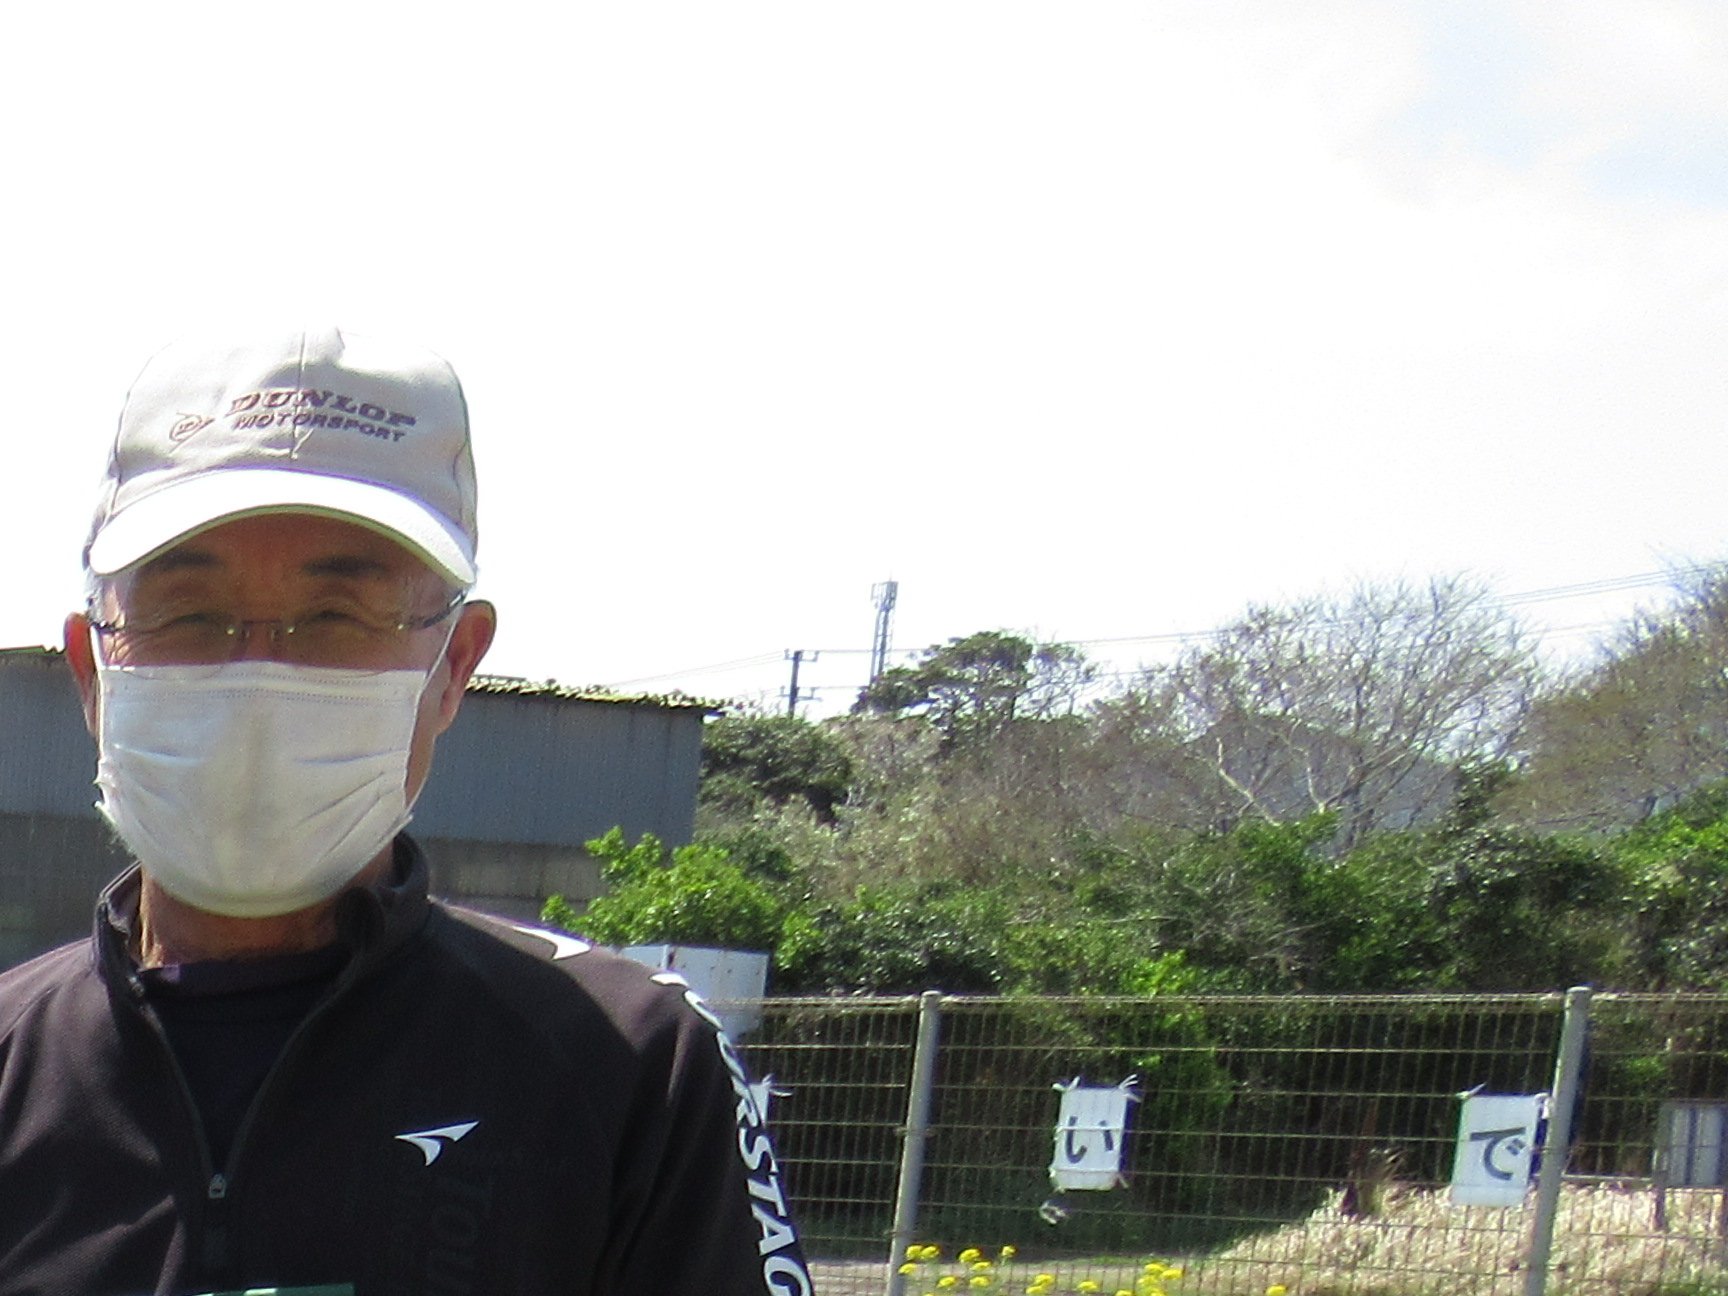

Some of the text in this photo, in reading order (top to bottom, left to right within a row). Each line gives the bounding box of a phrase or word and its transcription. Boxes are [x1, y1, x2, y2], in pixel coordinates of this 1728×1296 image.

[231, 390, 416, 426] DUNLOP
[234, 413, 406, 442] MOTORSPORT
[1065, 1115, 1115, 1164] い
[1470, 1126, 1527, 1180] で
